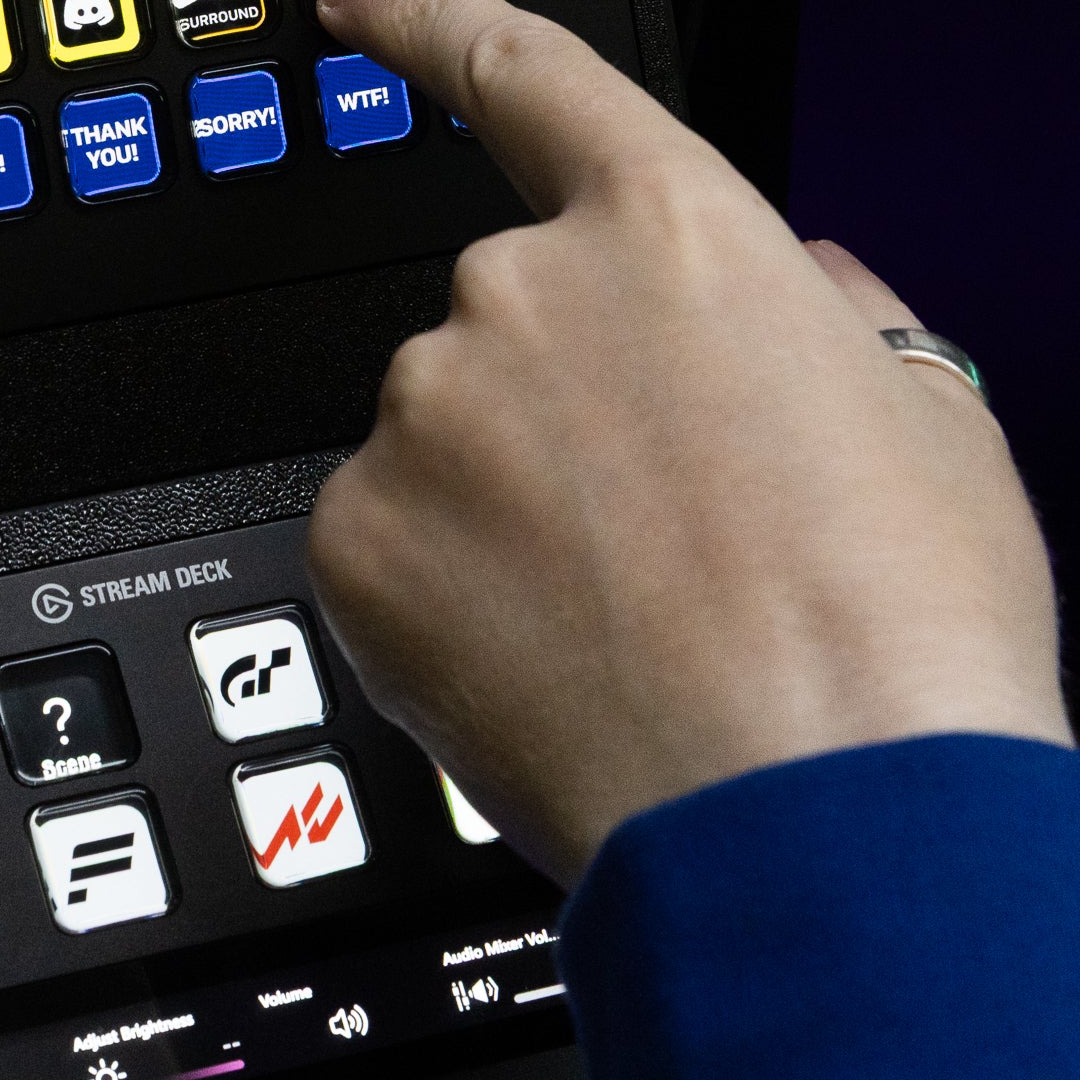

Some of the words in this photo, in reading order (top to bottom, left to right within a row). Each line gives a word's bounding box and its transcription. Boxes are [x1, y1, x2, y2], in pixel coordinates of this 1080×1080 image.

[179, 6, 259, 32] SURROUND
[336, 86, 390, 113] WTF!
[71, 116, 148, 147] THANK
[196, 106, 277, 138] SORRY!
[86, 143, 140, 170] YOU!
[80, 571, 171, 607] STREAM
[175, 558, 232, 588] DECK
[41, 753, 101, 780] Scene
[443, 945, 484, 967] Audio
[484, 938, 524, 956] Mixer
[258, 986, 313, 1009] Volume
[73, 1029, 119, 1053] Adjust
[120, 1013, 195, 1041] Brightness
